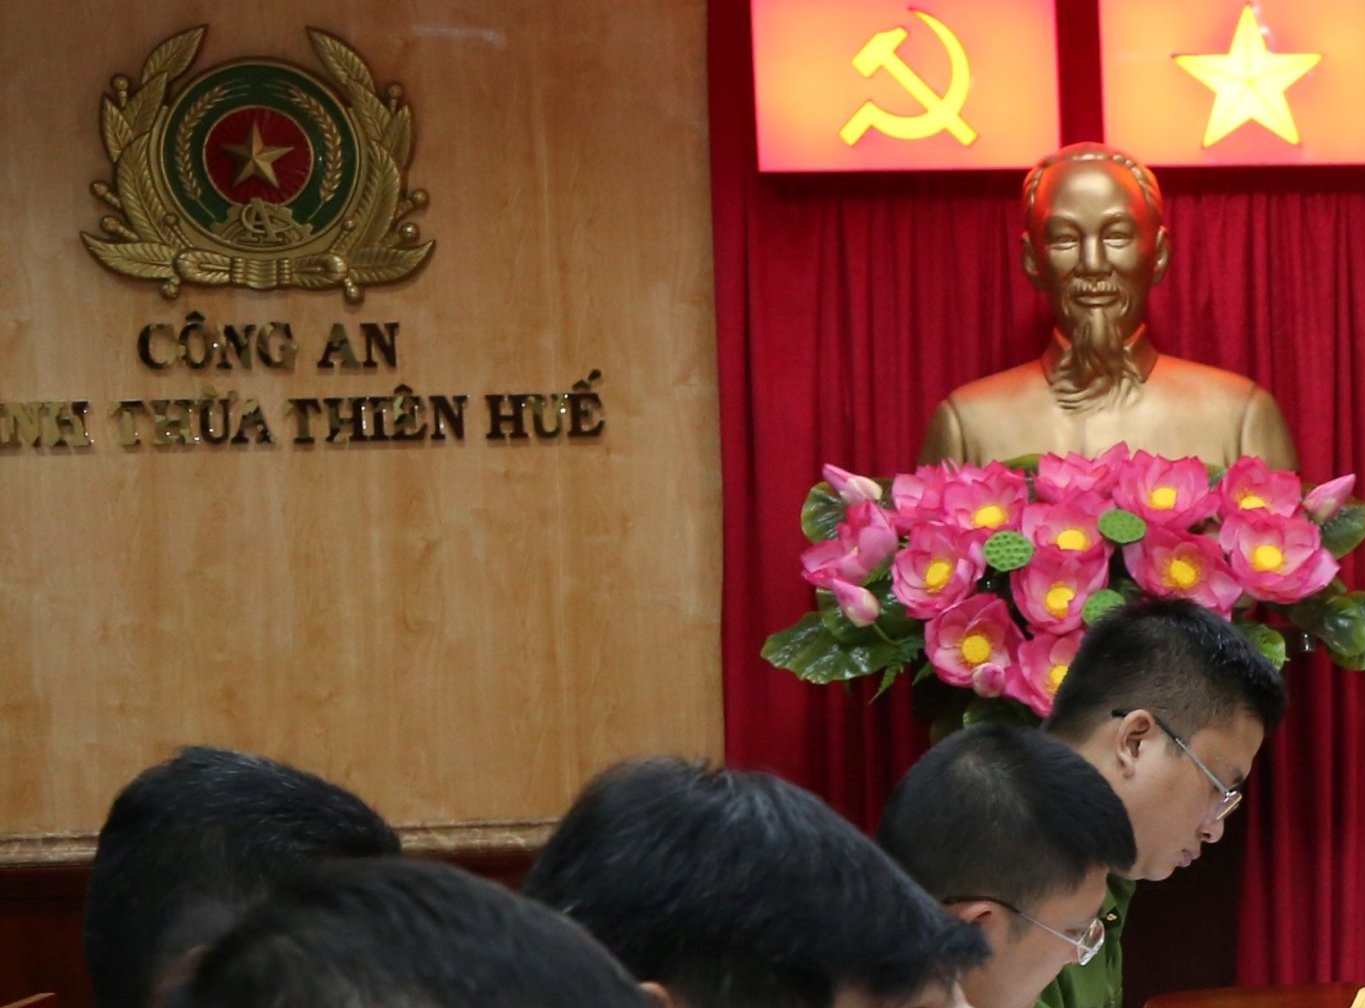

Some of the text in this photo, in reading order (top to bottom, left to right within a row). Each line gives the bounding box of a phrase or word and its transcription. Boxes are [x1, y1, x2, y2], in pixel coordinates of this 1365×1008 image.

[137, 312, 399, 370] CÔNG AN
[108, 385, 276, 446] THỪA
[287, 384, 468, 445] THIÊN
[484, 369, 606, 440] HUẾ
